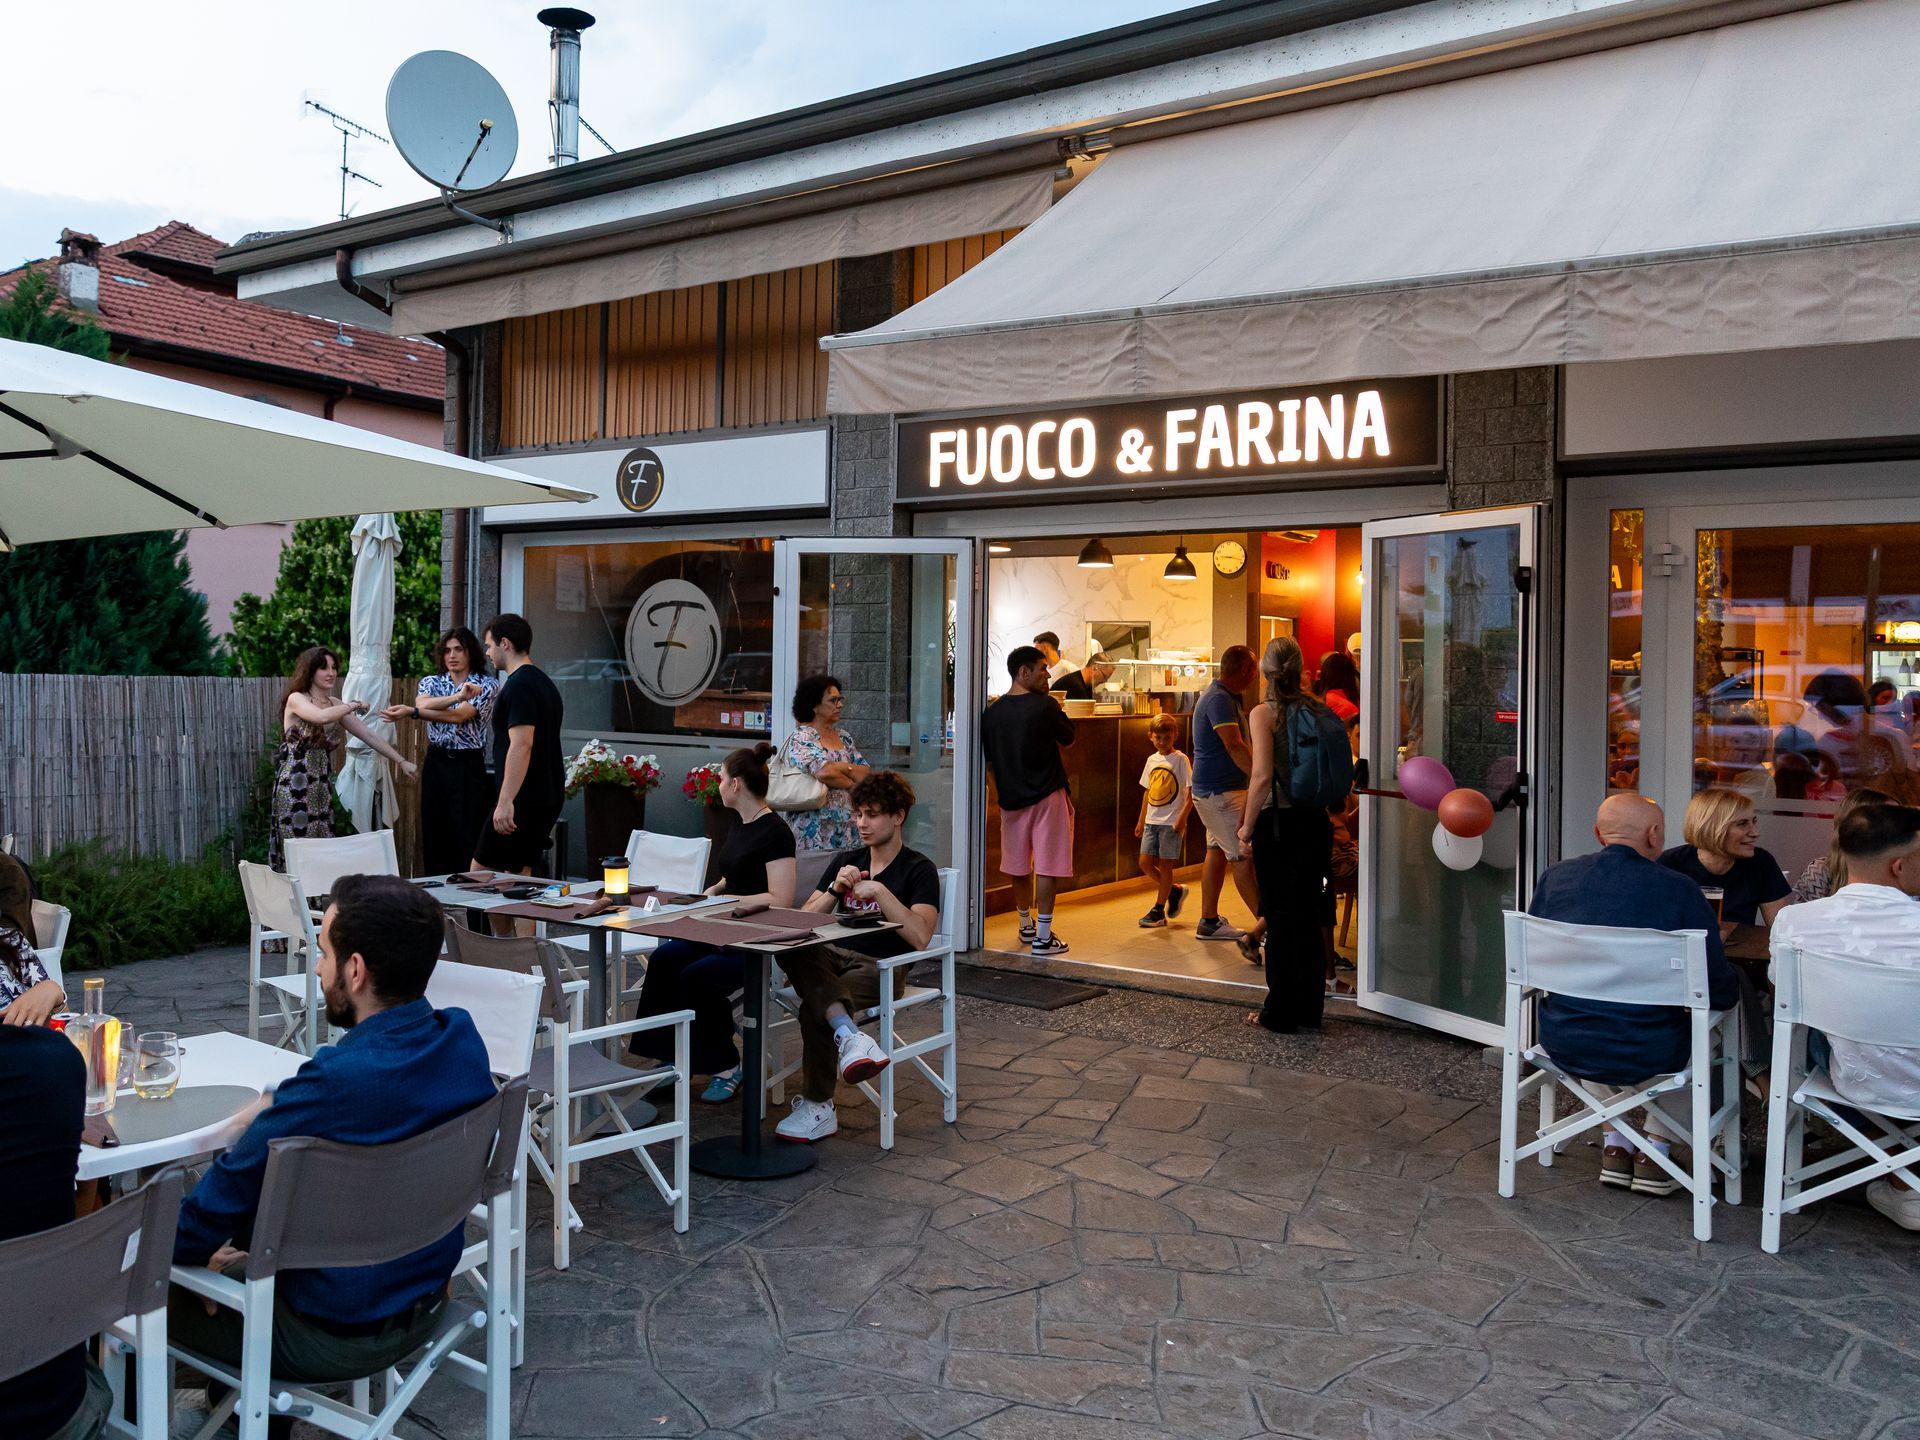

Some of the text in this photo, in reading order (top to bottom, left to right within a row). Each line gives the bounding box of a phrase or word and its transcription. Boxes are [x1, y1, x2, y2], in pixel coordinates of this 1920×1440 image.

[929, 390, 1390, 488] FUOCO & FARINA
